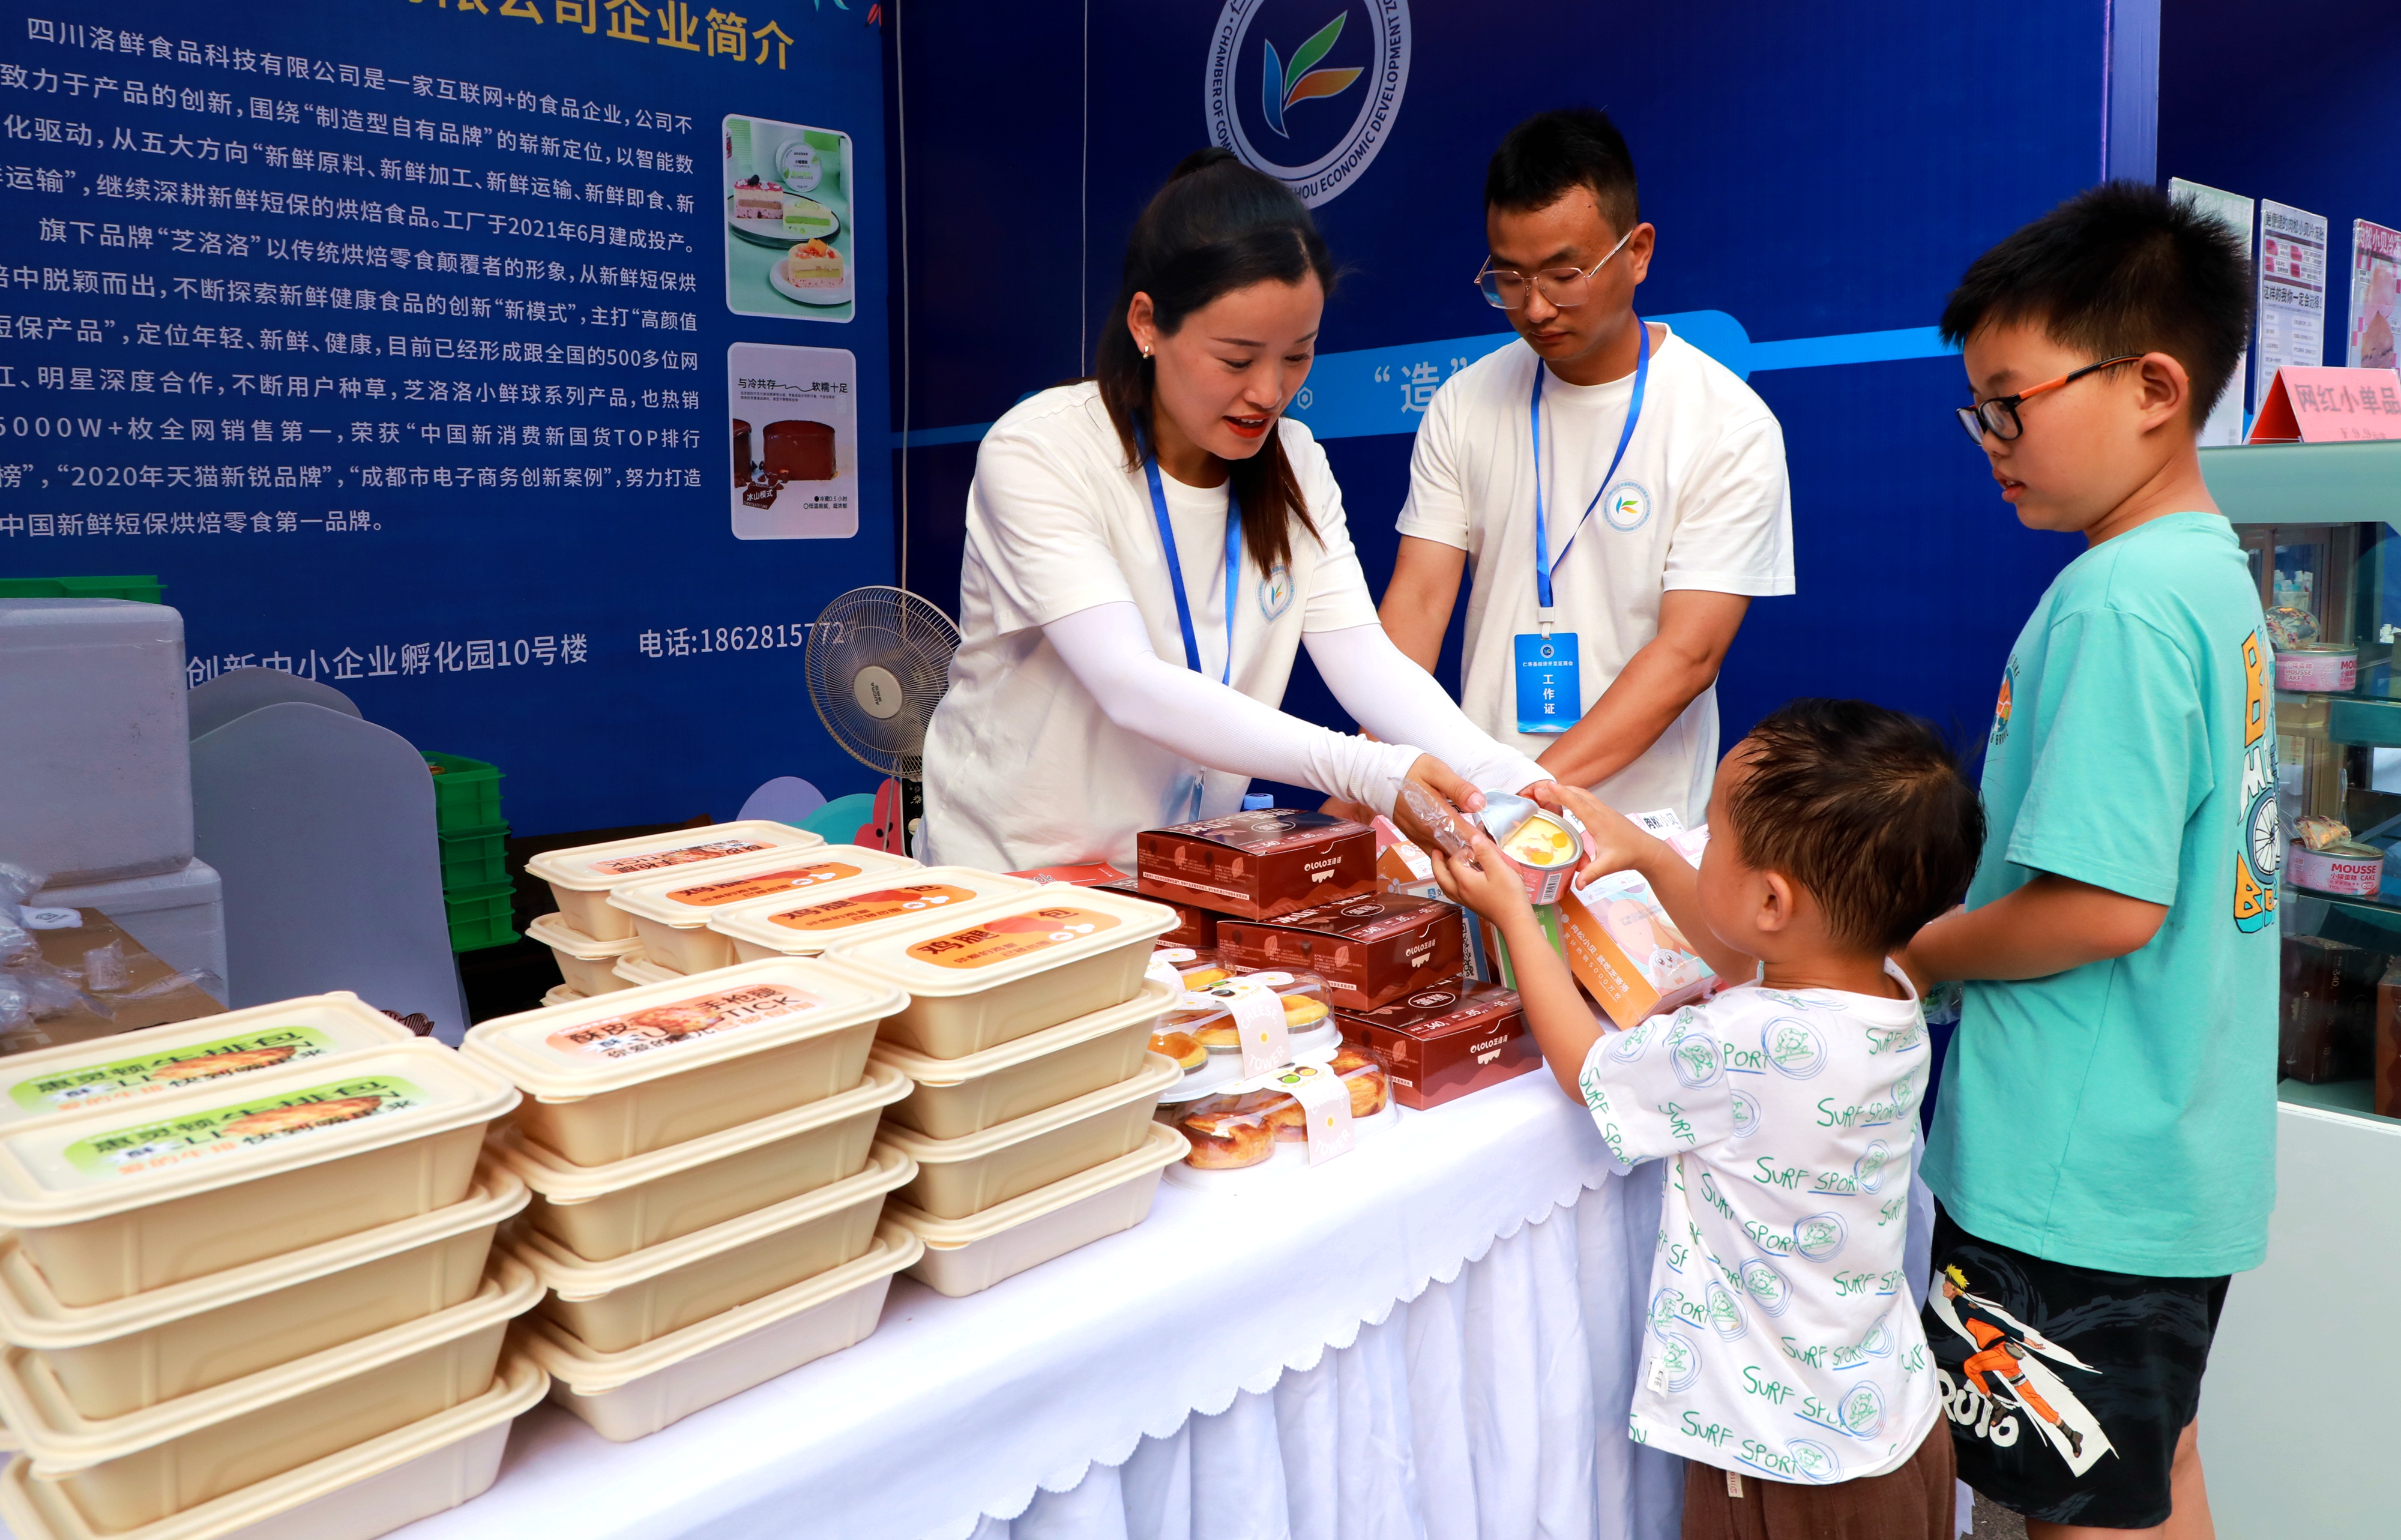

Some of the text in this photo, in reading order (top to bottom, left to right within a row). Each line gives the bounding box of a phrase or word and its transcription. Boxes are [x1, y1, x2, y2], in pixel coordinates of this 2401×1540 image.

[408, 0, 794, 70] 公司企业简介
[1213, 26, 1233, 97] CHAMBER
[1370, 16, 1401, 133] DEVELOPMENT
[1213, 98, 1223, 118] OF
[1321, 131, 1376, 193] ECONOMIC
[0, 164, 693, 254] 运输”，继续深耕新鲜短保的烘焙食品。工厂于2021年6月建成投产。
[738, 377, 848, 394] 与冷共存 软糯十足
[2295, 384, 2401, 415] 网红小单品
[747, 489, 773, 502] 冰山模式
[0, 510, 382, 537] 中国新鲜短保烘焙零食第一品牌。
[870, 682, 880, 706] AUCMA
[1543, 674, 1555, 714] 工作证
[1643, 813, 1679, 830] 肉松小贝
[2331, 863, 2377, 874] MOUSSE
[778, 900, 858, 921] 鸡腿
[916, 907, 1080, 956] 鸡腿 包
[719, 996, 800, 1023] TICK
[1413, 993, 1451, 1006] 蛋糕
[1241, 1005, 1279, 1030] CHEESE
[565, 1021, 641, 1044] 酥皮
[1865, 1027, 1902, 1055] SURF
[1248, 1044, 1286, 1071] TOWER
[1723, 1043, 1771, 1069] PORT
[1580, 1067, 1610, 1115] SURF
[1658, 1102, 1696, 1146] SURF
[1817, 1098, 1902, 1128] SURF SPORT
[1315, 1128, 1351, 1156] TOWER
[1753, 1156, 1862, 1193] SURF SPORT
[1744, 1220, 1800, 1253] SPORT
[1833, 1271, 1876, 1297] SURF
[1781, 1336, 1828, 1370] SURF
[1743, 1365, 1795, 1406] SURF
[1681, 1410, 1798, 1475] SURF SPORT
